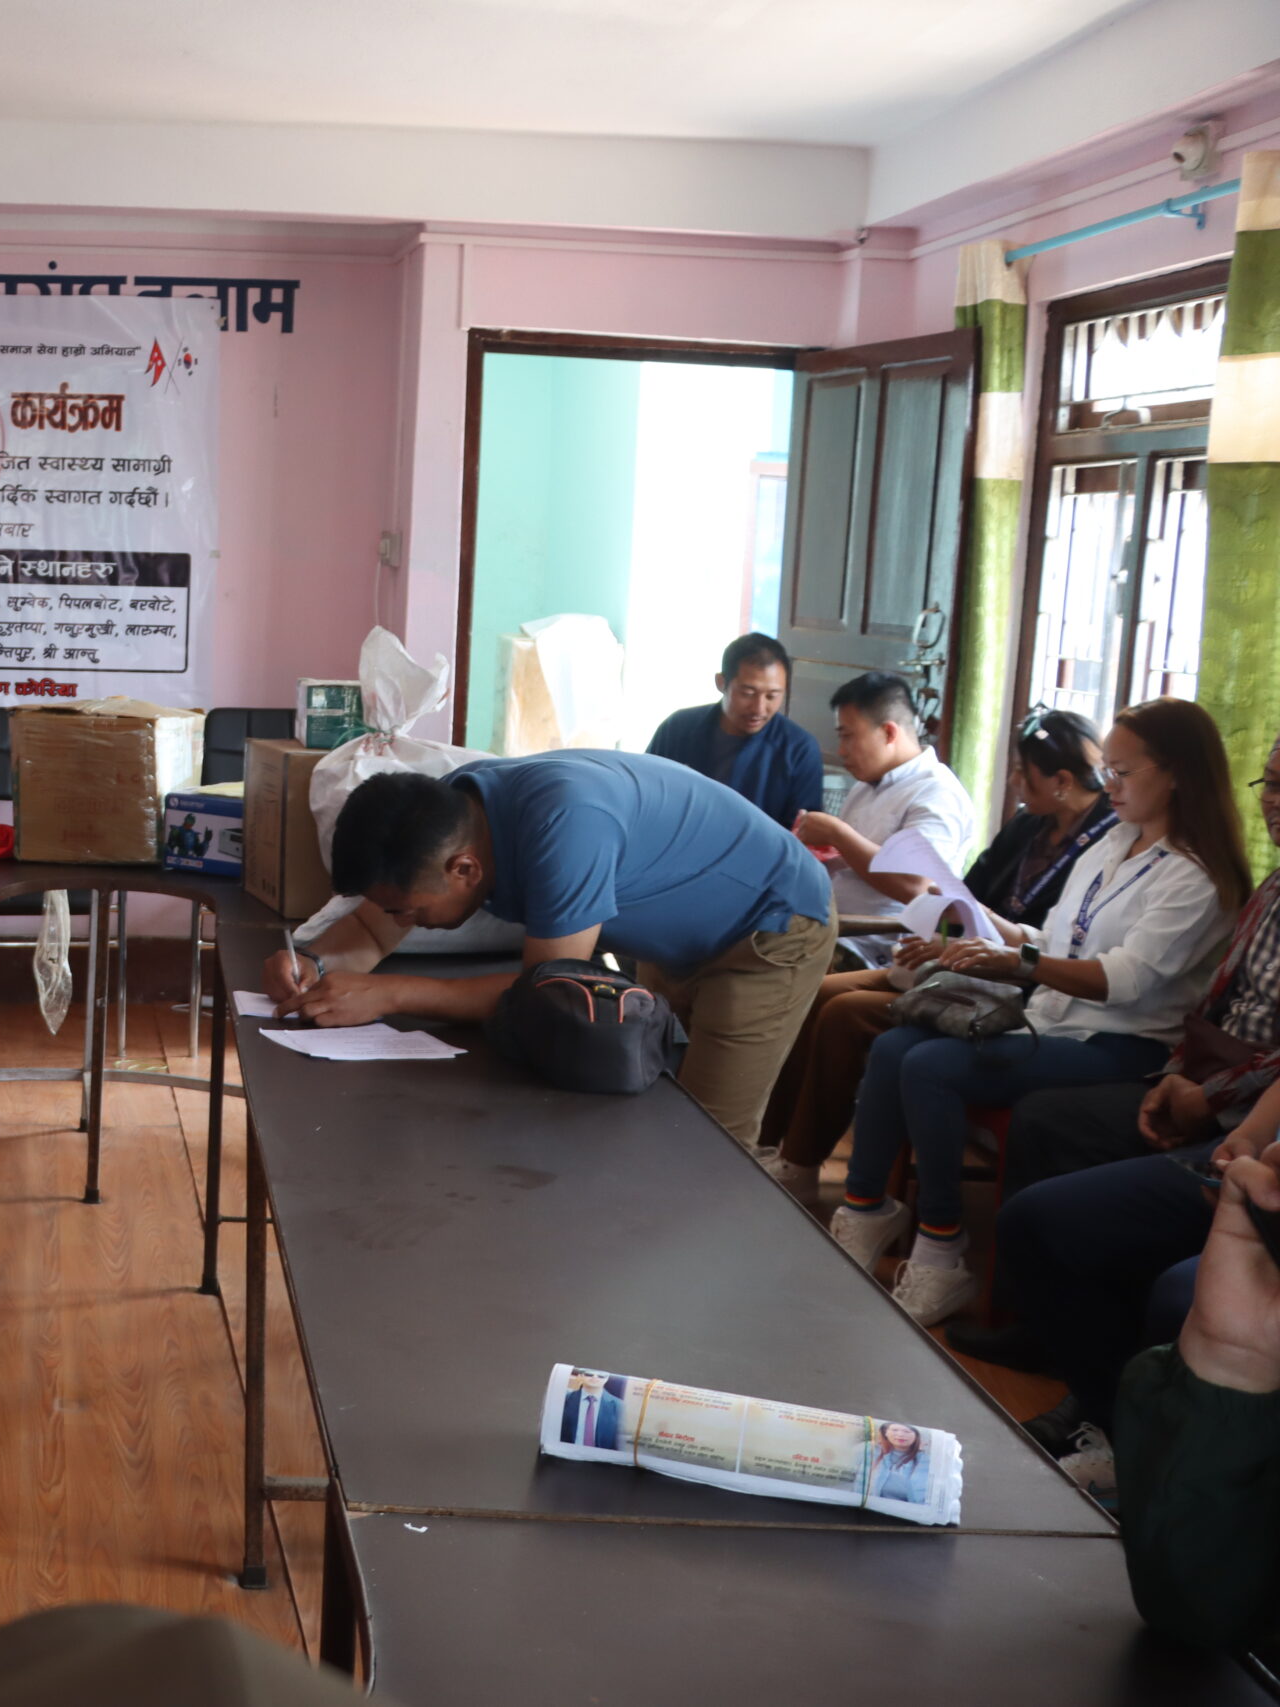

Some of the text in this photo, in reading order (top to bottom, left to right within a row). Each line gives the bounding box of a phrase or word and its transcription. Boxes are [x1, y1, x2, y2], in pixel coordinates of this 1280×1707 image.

[0, 345, 33, 355] समाज
[36, 343, 57, 355] सेवा
[10, 382, 126, 433] कार्यक्रम
[37, 456, 104, 474] स्वास्थ्य
[111, 454, 173, 476] सामाग्री
[44, 490, 103, 505] स्वागत
[19, 559, 118, 580] स्थानहरु
[42, 643, 59, 660] श्री
[14, 677, 79, 698] कोरिया
